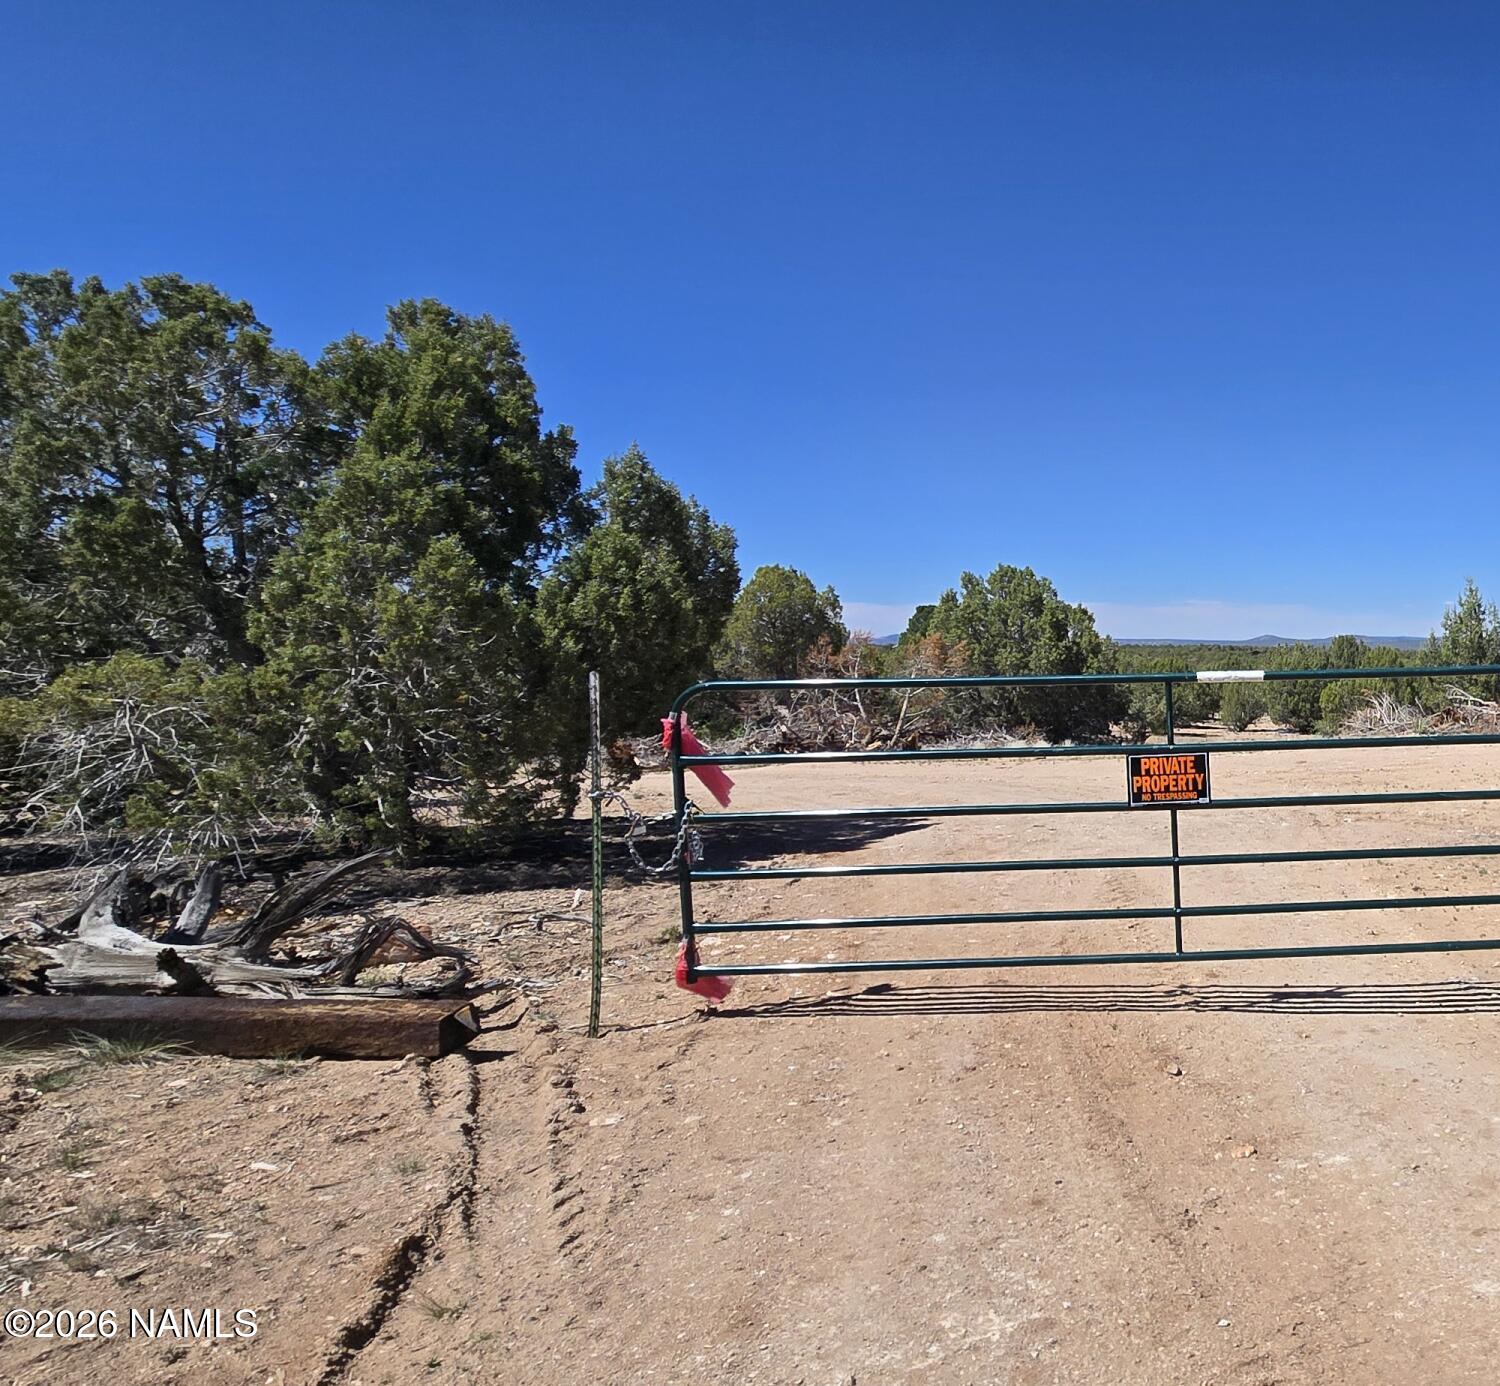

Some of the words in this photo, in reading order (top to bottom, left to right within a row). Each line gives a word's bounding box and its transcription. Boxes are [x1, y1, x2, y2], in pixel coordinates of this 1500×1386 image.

[1141, 756, 1196, 775] PRIVATE
[1133, 773, 1204, 793] PROPERTY
[1142, 793, 1152, 801] NO
[1153, 792, 1198, 800] TRESPASSING
